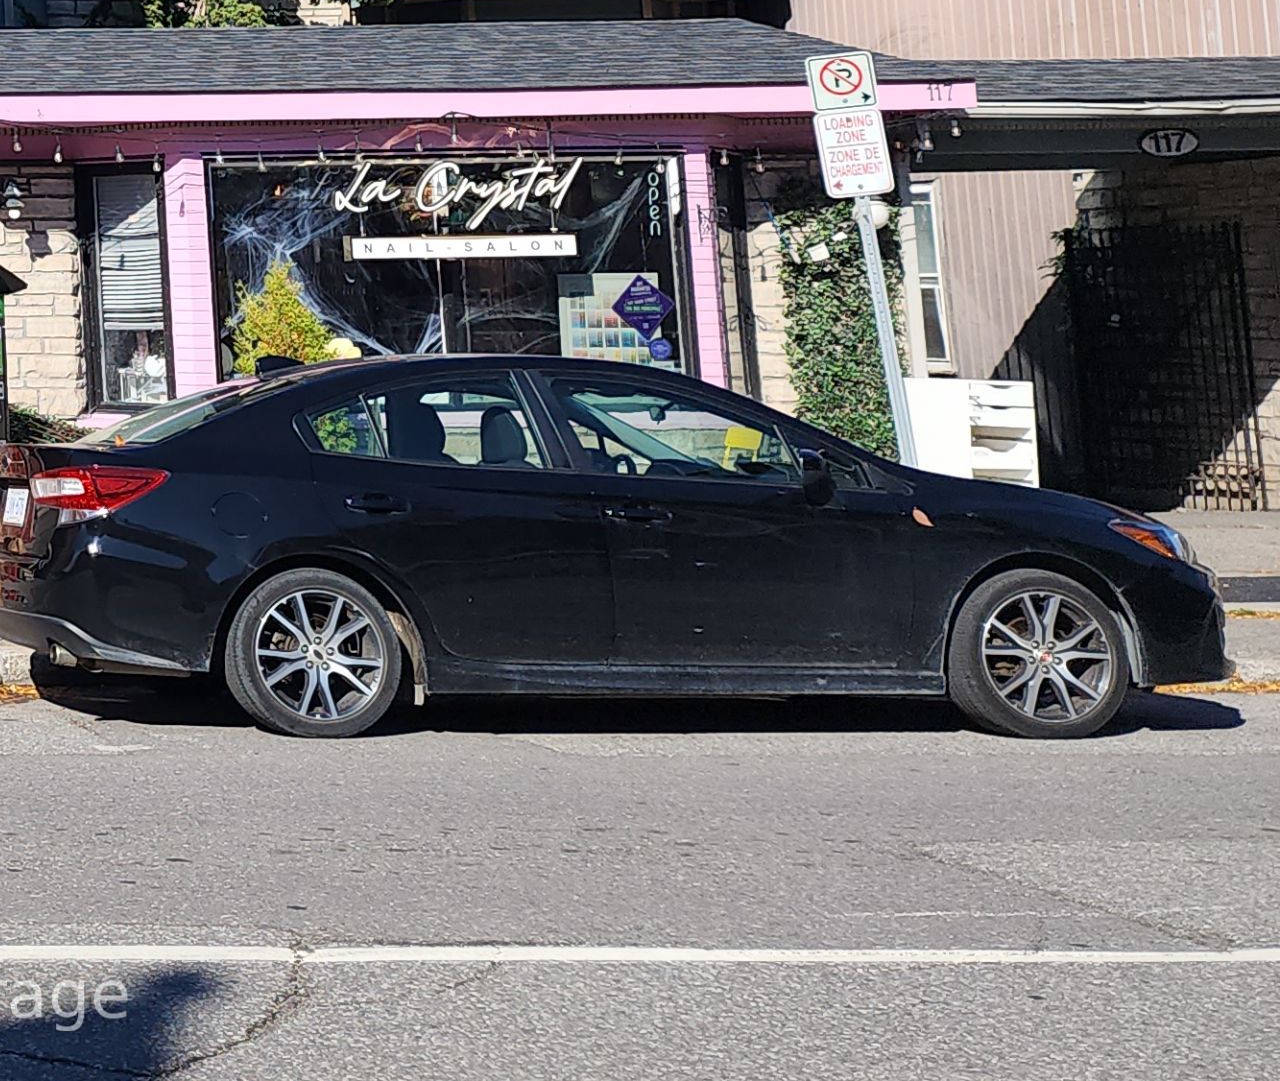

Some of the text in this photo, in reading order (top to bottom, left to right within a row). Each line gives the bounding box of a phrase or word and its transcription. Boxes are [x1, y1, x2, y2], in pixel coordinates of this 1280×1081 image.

[824, 114, 874, 132] LOADING
[835, 129, 867, 144] ZONE
[1149, 131, 1187, 153] 117
[828, 147, 881, 164] ZONE DE
[829, 161, 884, 179] CHARGEMENT
[333, 156, 584, 231] La Crystal
[647, 172, 661, 237] open
